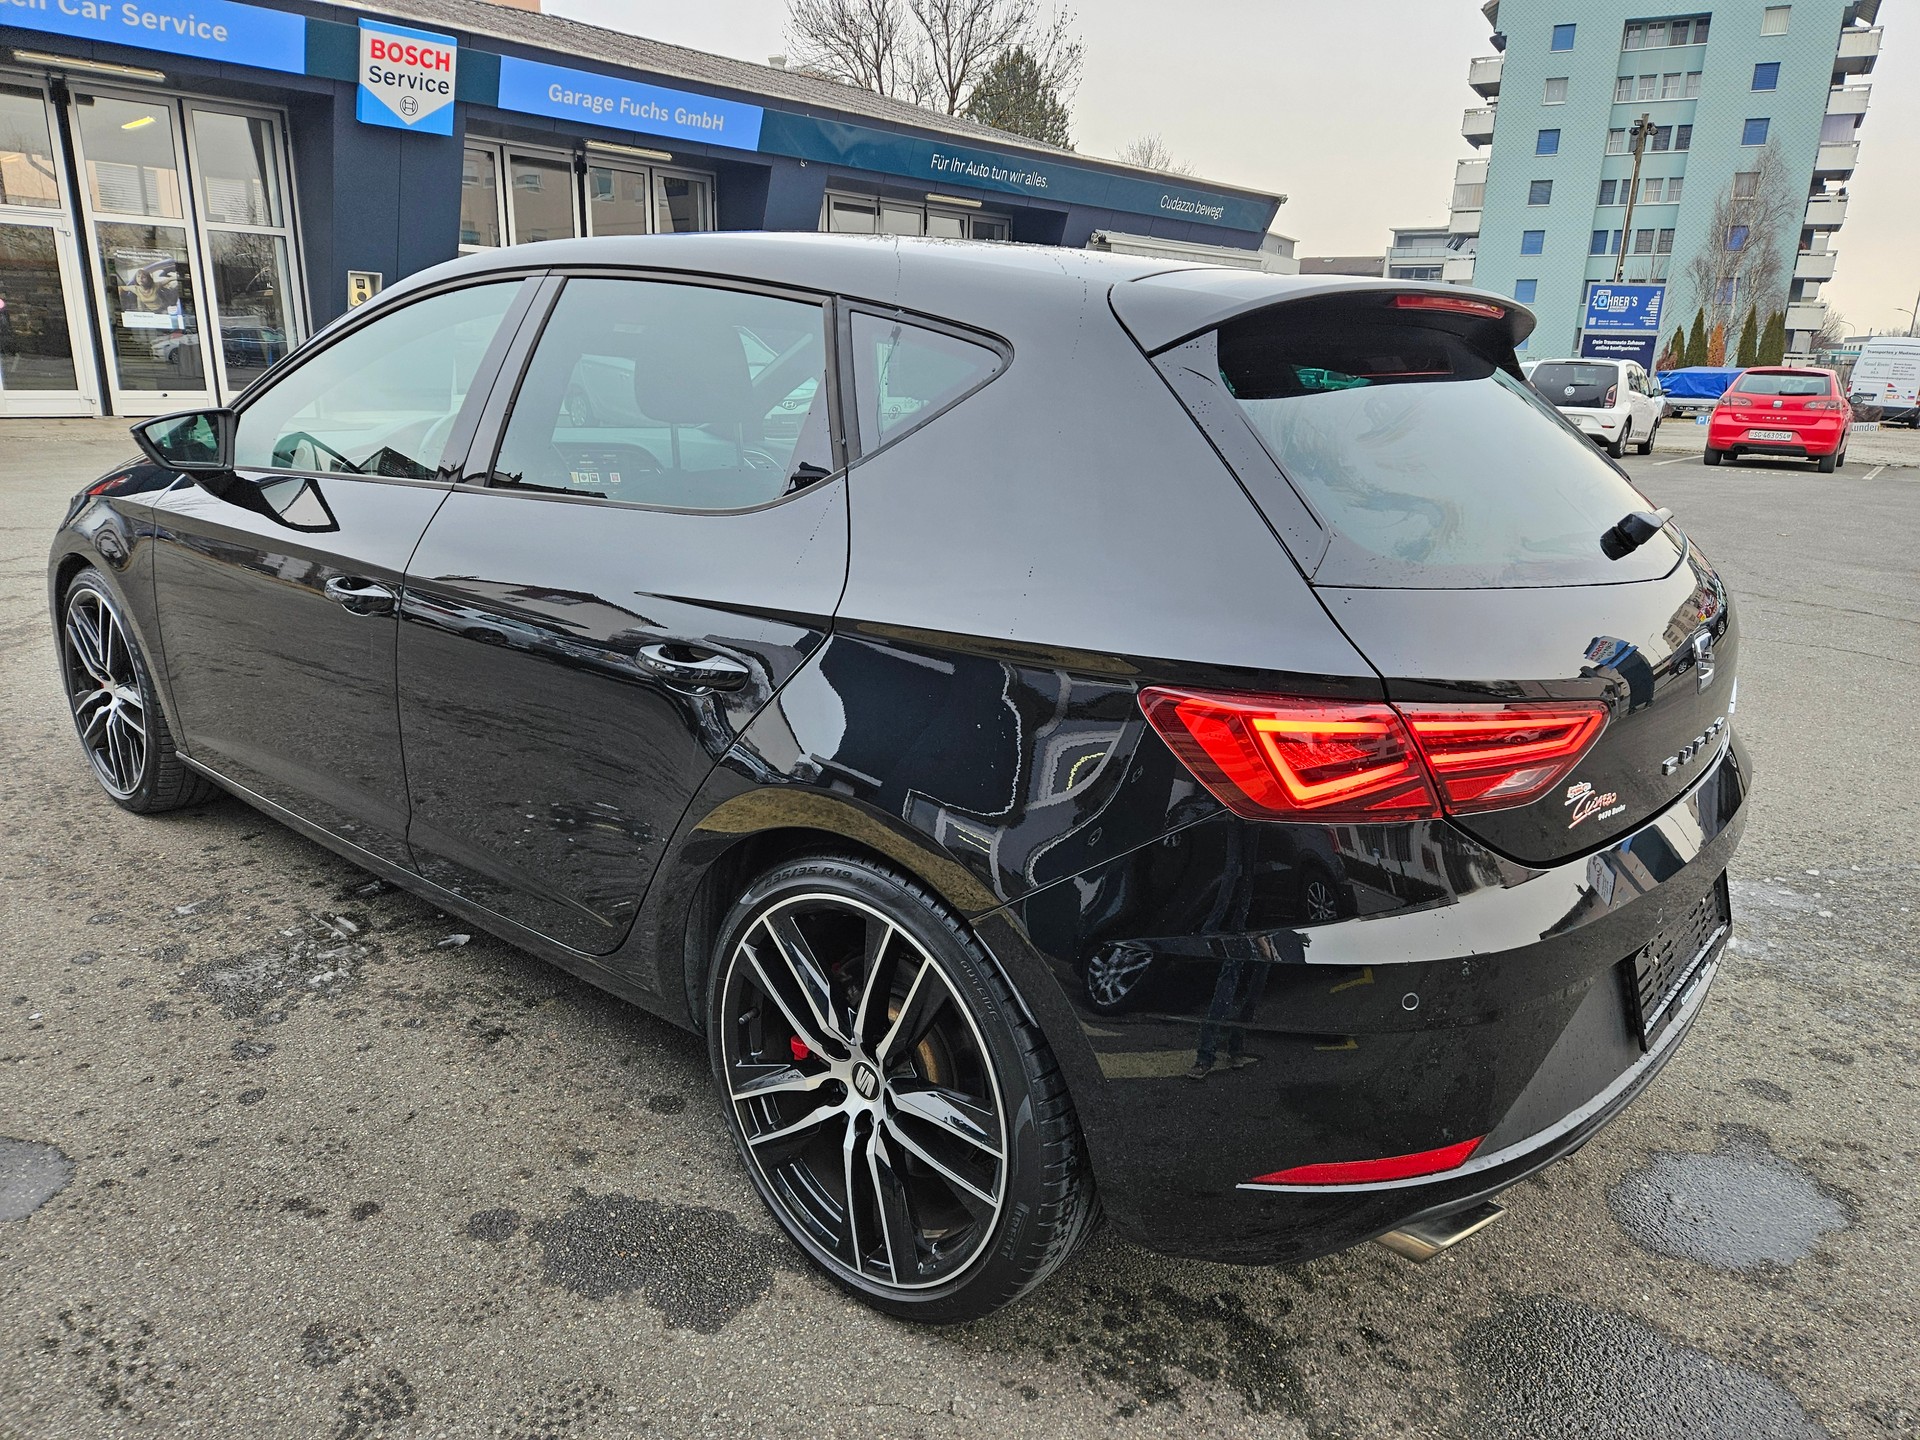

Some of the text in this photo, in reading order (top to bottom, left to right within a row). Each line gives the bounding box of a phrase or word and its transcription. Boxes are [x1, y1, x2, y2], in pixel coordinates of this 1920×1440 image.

[58, 0, 228, 42] Car Service
[369, 38, 451, 73] BOSCH
[368, 65, 450, 95] Service
[548, 83, 725, 132] Garage Fuchs GmbH
[930, 153, 1049, 188] Für Ihr Auto tun wir alles.
[1160, 194, 1224, 219] Cudazzo bewegt
